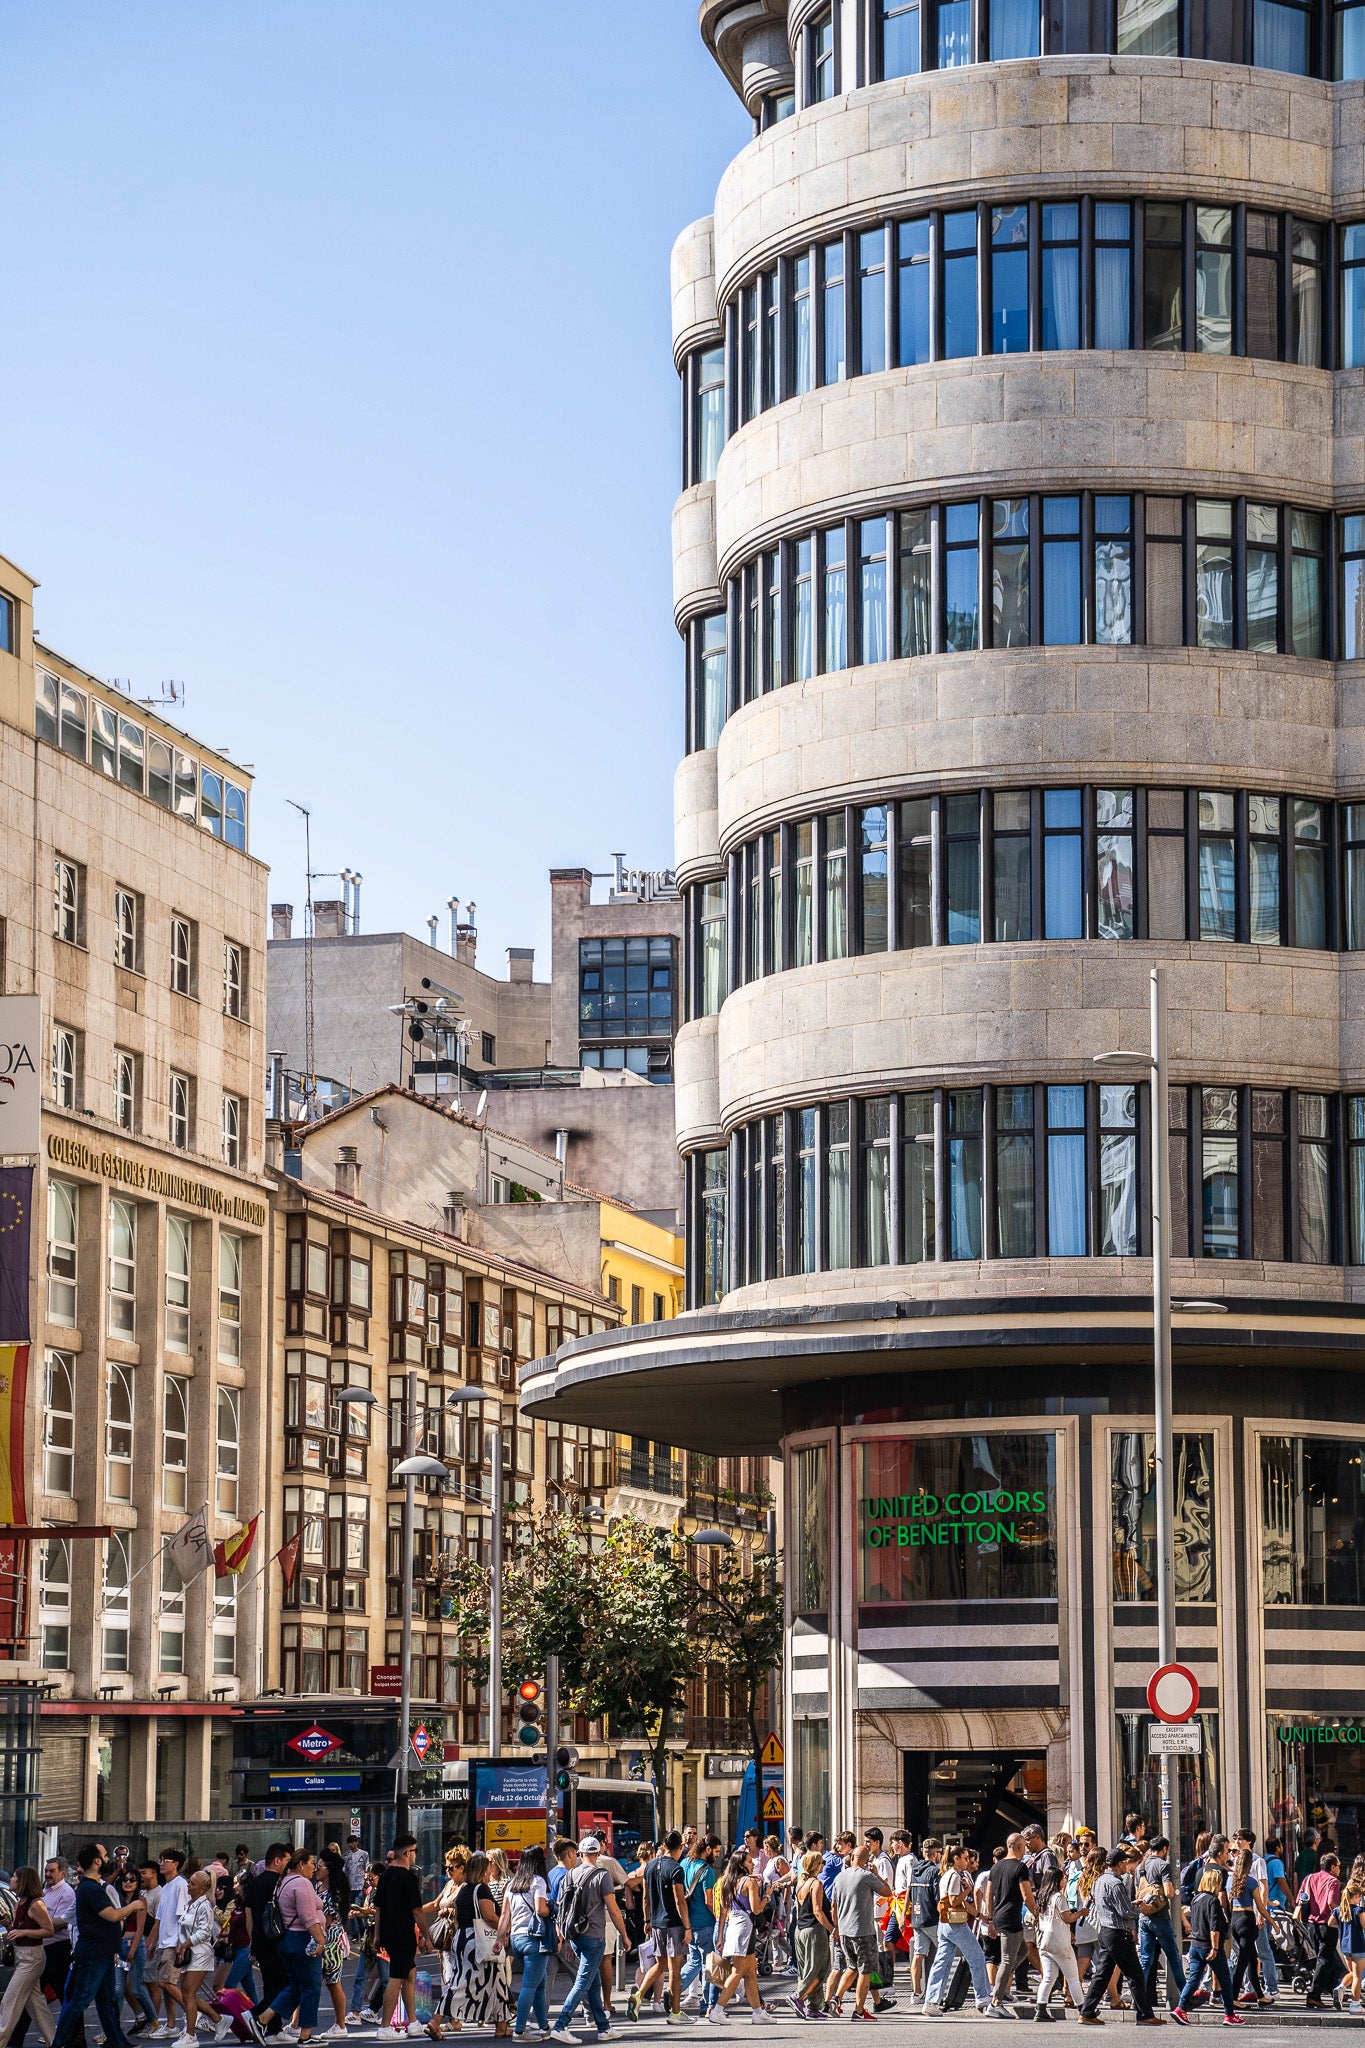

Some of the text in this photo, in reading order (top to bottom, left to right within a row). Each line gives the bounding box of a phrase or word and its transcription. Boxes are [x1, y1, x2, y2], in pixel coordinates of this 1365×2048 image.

[48, 1134, 265, 1228] COLEGIO DE GESTORES ADMINISTRATIVOS DE MADRID
[867, 1491, 1046, 1518] UNITED COLORS
[867, 1521, 1021, 1547] OF BENETTON.
[302, 1739, 328, 1748] Metro
[1280, 1727, 1365, 1743] UNITED COL
[304, 1777, 326, 1785] Callao
